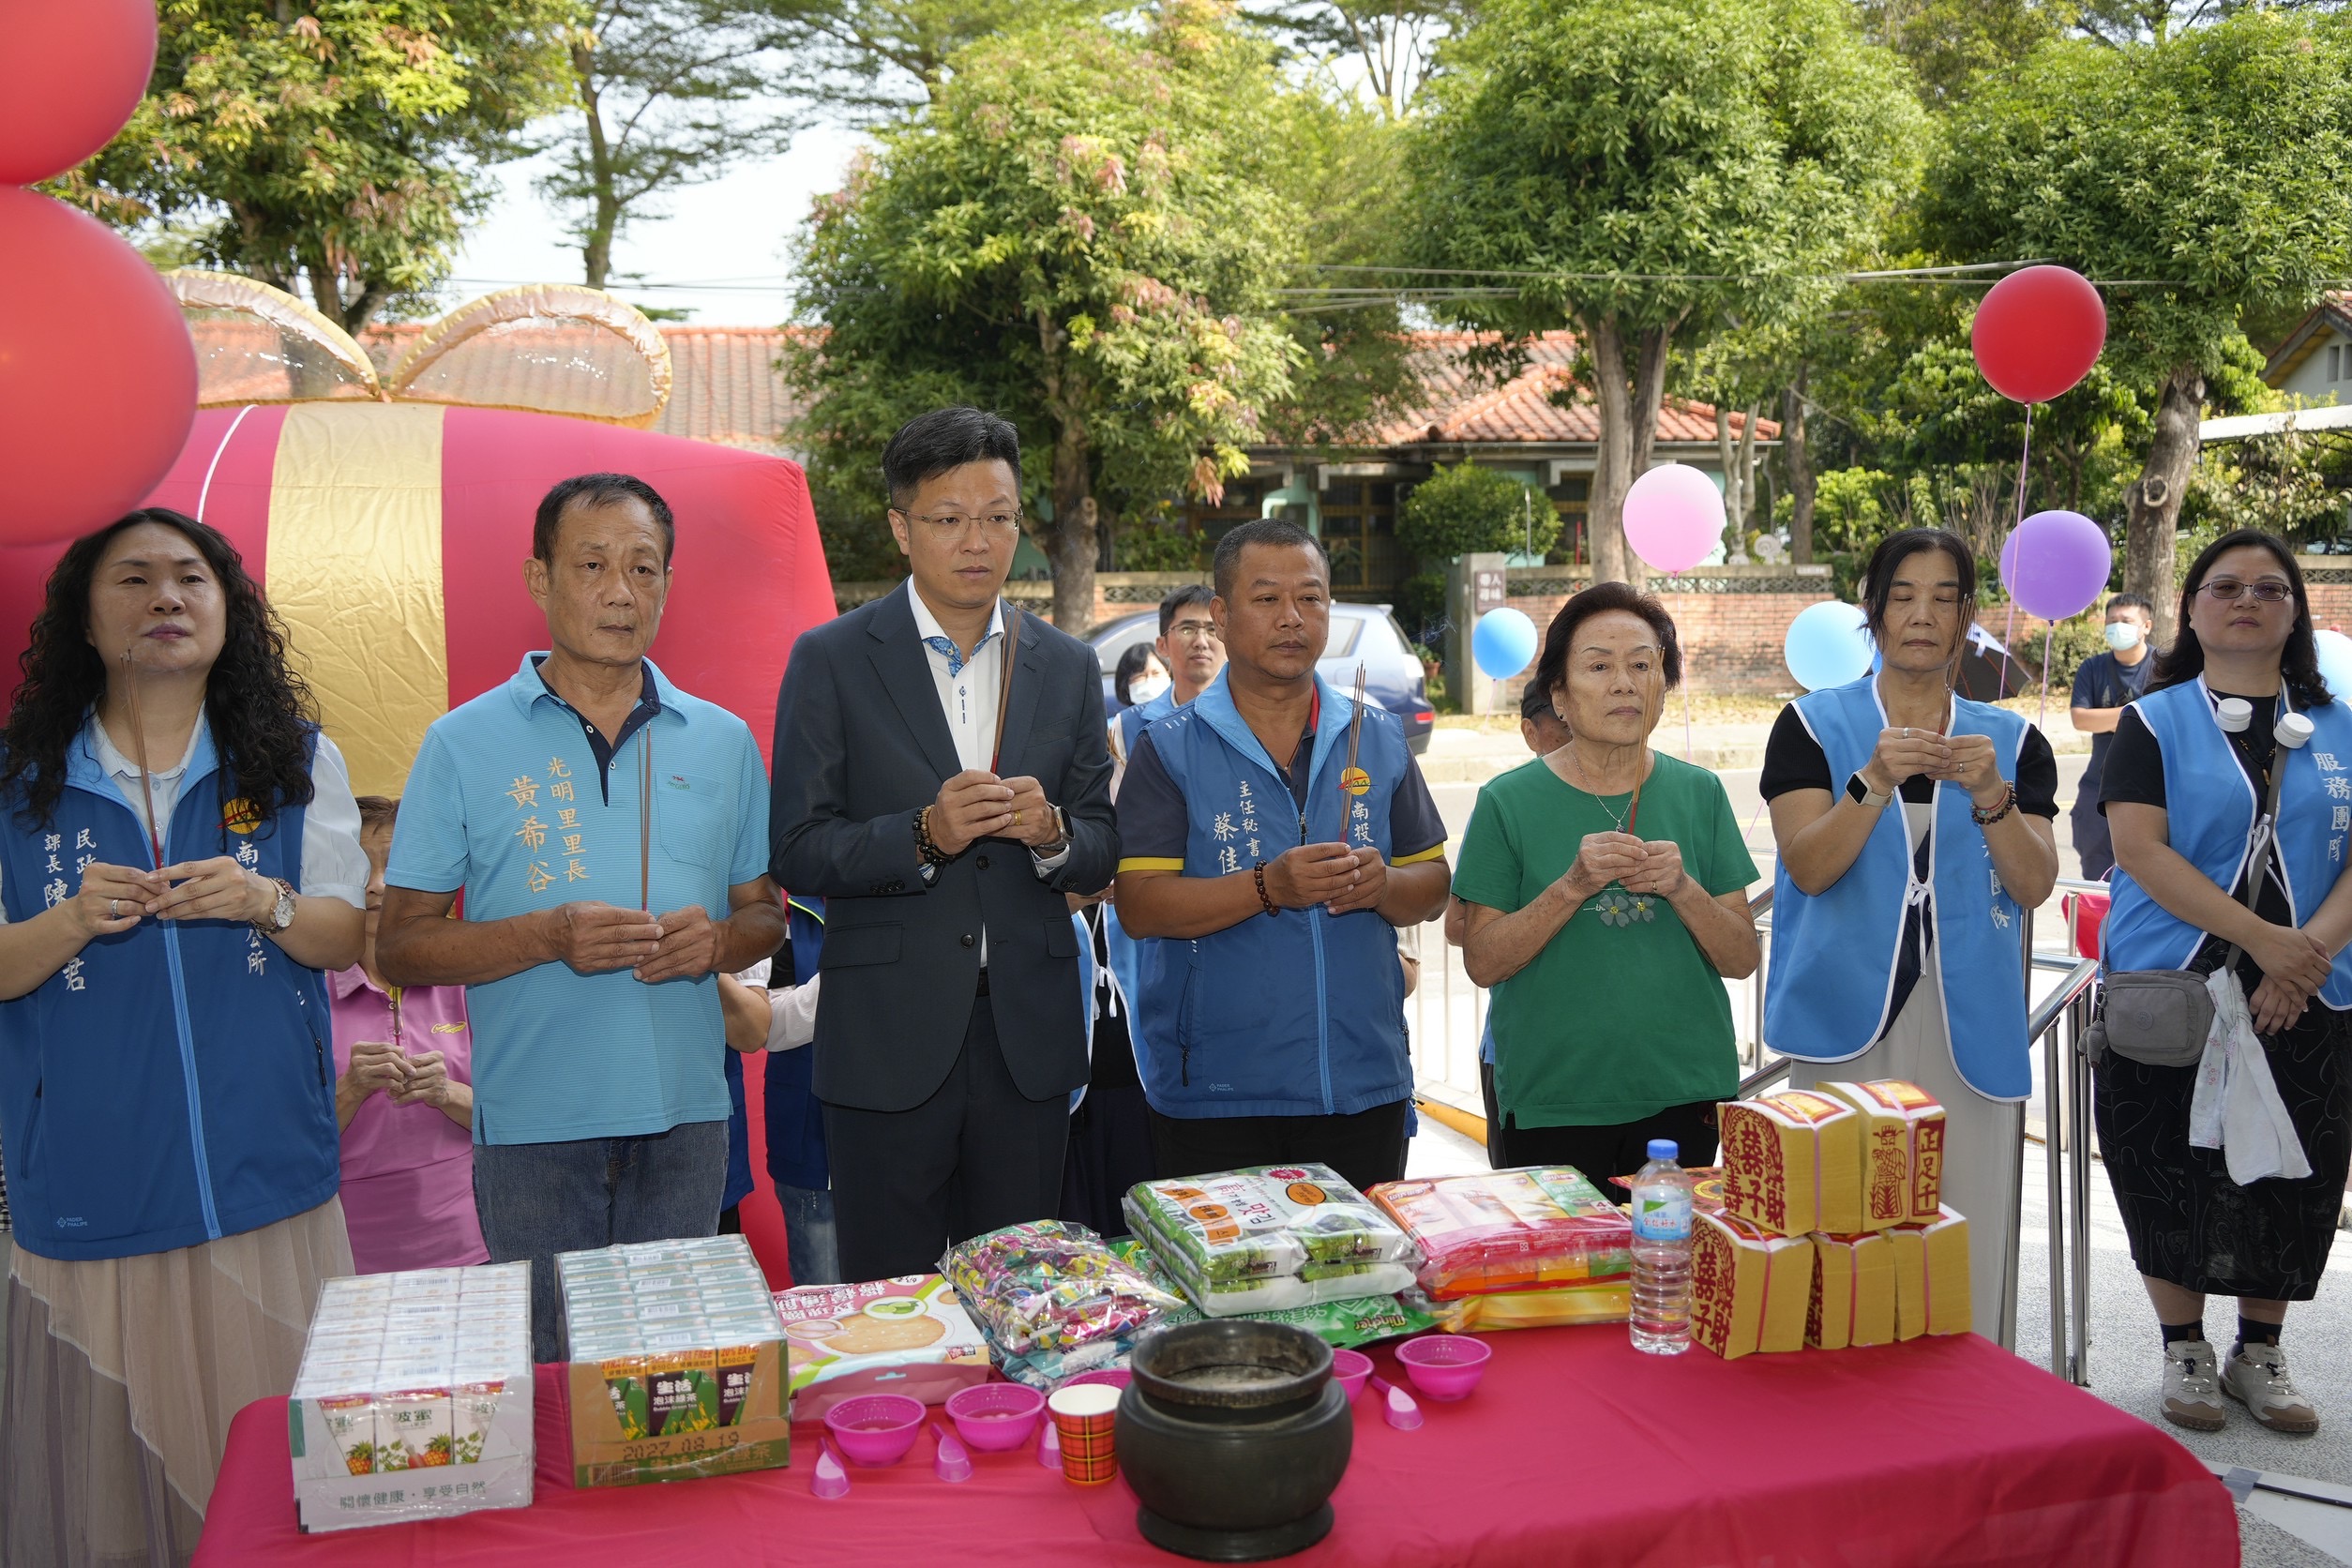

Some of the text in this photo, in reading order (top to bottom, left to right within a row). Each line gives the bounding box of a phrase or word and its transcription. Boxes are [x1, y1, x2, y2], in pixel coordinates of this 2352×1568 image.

[505, 775, 557, 894] 黃希谷
[547, 756, 590, 883] 光明里里長
[1239, 780, 1260, 858] 主任秘書
[1350, 800, 1375, 848] 南投
[76, 827, 98, 890] 民政
[235, 839, 267, 977] 南公所
[1918, 1129, 1939, 1209] 正足千
[653, 1393, 698, 1407] 泡沫綠茶
[656, 1379, 693, 1395] 生活
